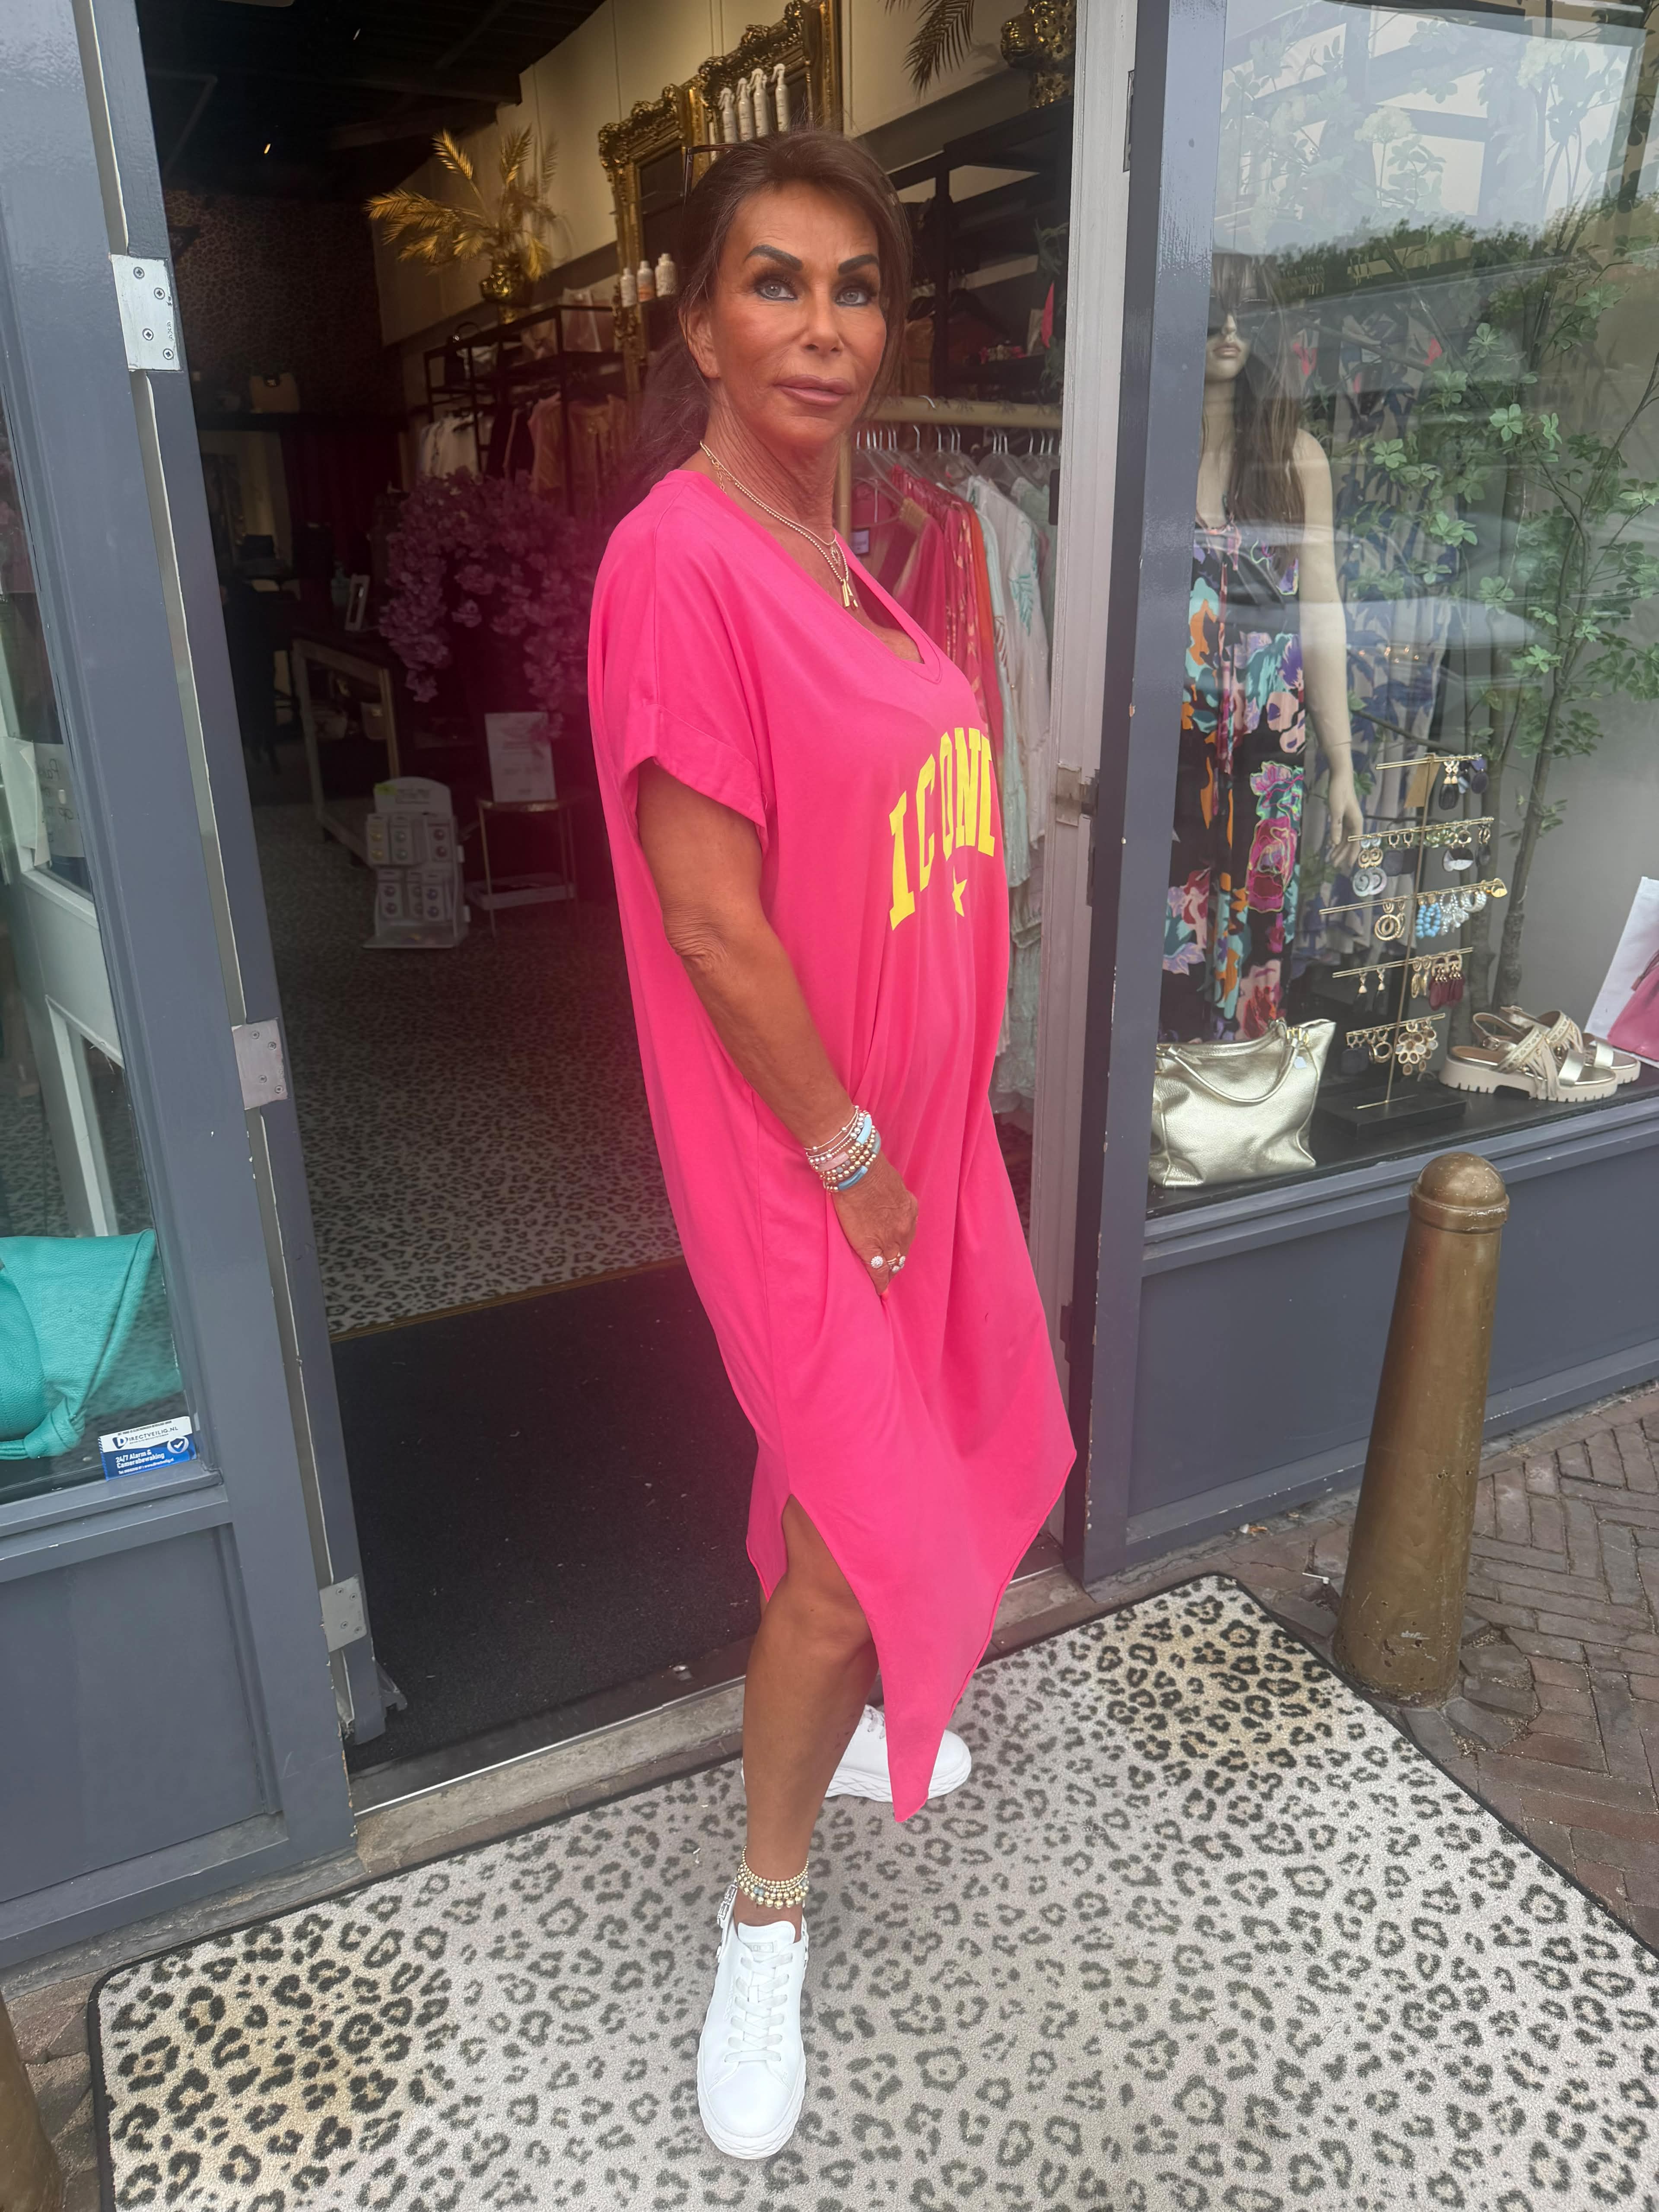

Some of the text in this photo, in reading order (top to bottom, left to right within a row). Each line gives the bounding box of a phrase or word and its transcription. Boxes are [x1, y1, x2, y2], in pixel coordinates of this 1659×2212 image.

[113, 1427, 178, 1448] DIRECTVEILIG.NL
[115, 1453, 128, 1463] 24/7
[129, 1451, 146, 1460] Alarm
[117, 1452, 165, 1468] Camerabewaking
